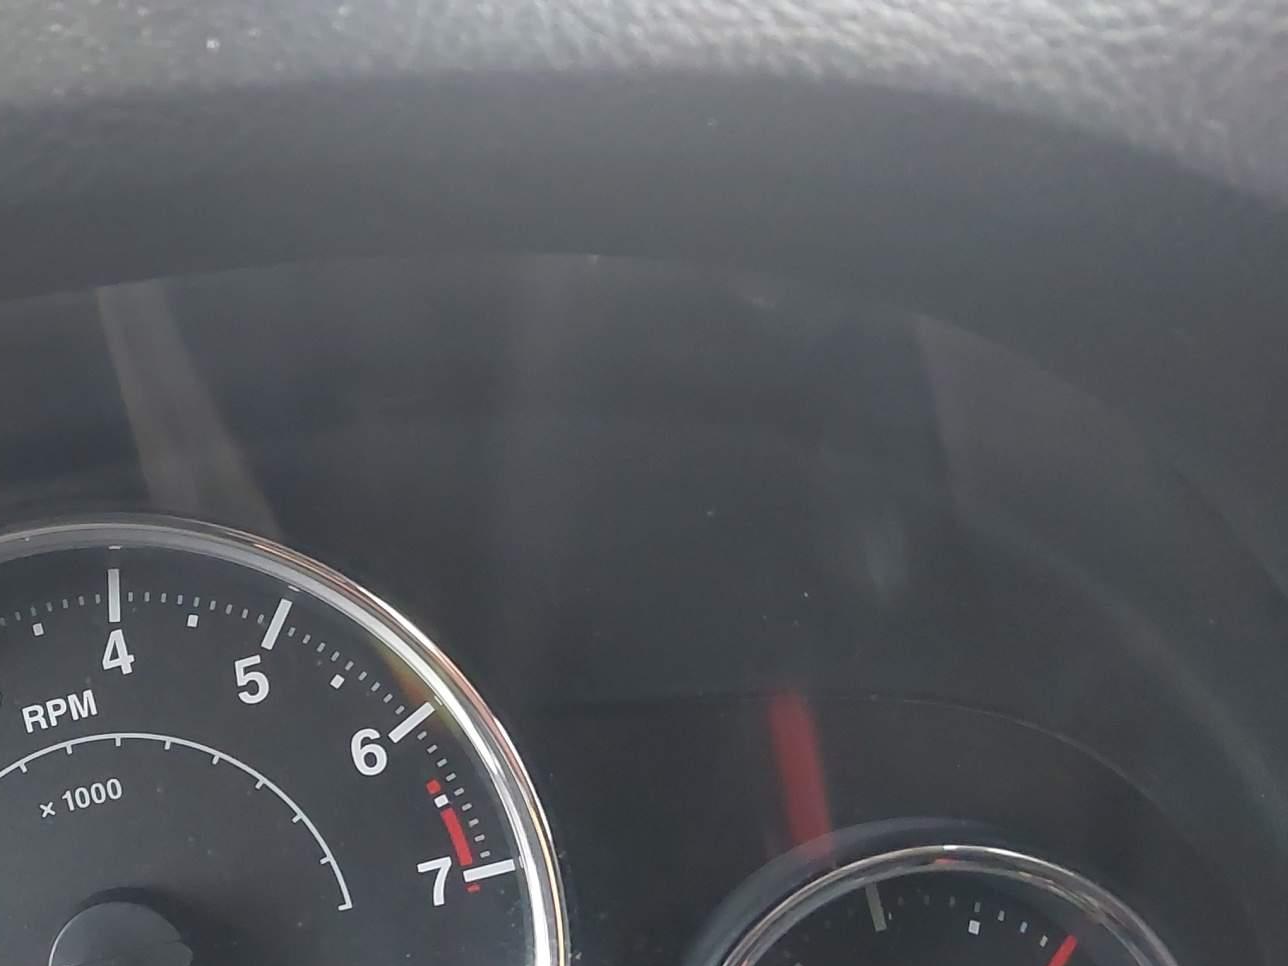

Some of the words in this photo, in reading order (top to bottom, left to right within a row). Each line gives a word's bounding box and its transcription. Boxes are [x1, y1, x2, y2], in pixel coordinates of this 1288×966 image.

[101, 630, 135, 676] 4
[234, 657, 270, 705] 5
[22, 689, 98, 733] RPM
[350, 728, 388, 776] 6
[61, 778, 123, 811] 1000
[417, 858, 454, 906] 7
